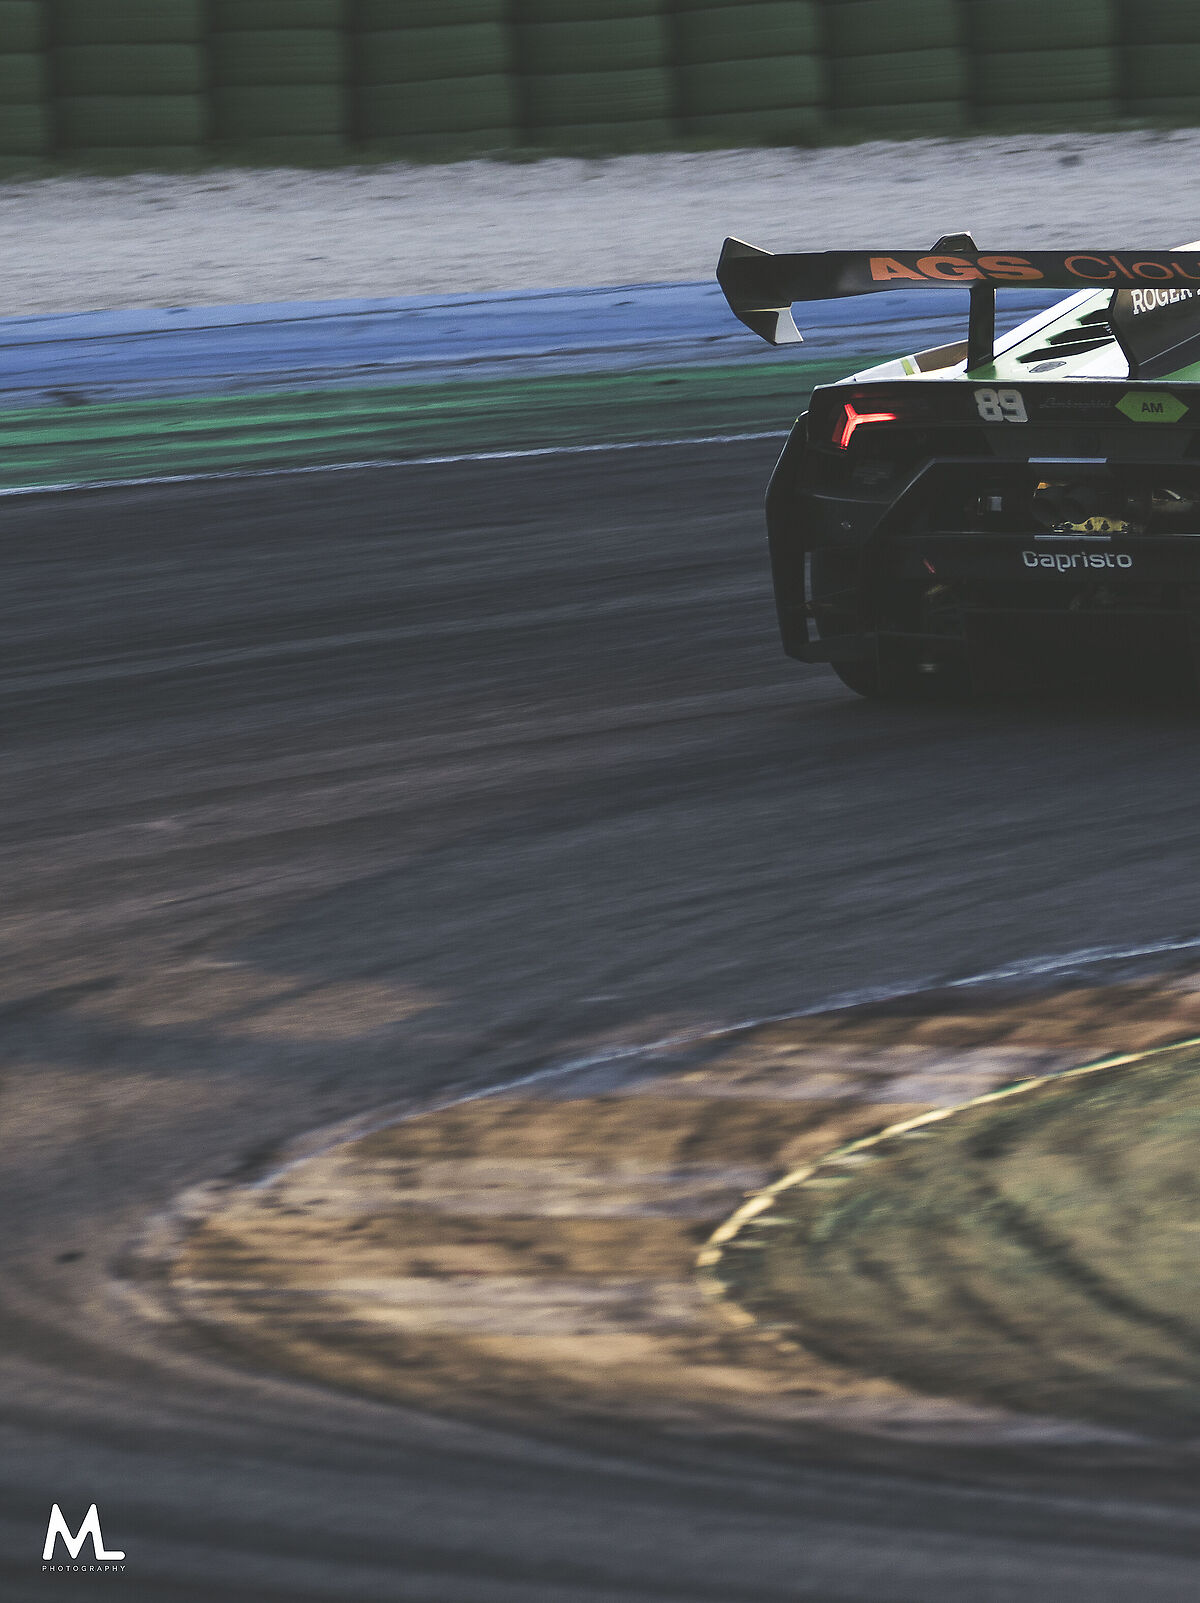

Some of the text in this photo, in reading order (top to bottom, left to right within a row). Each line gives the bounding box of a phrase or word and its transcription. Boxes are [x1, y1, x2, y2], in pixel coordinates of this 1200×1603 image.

[869, 256, 1044, 281] AGS
[974, 388, 1028, 423] 89
[1141, 402, 1164, 413] AM
[1022, 550, 1133, 573] Capristo
